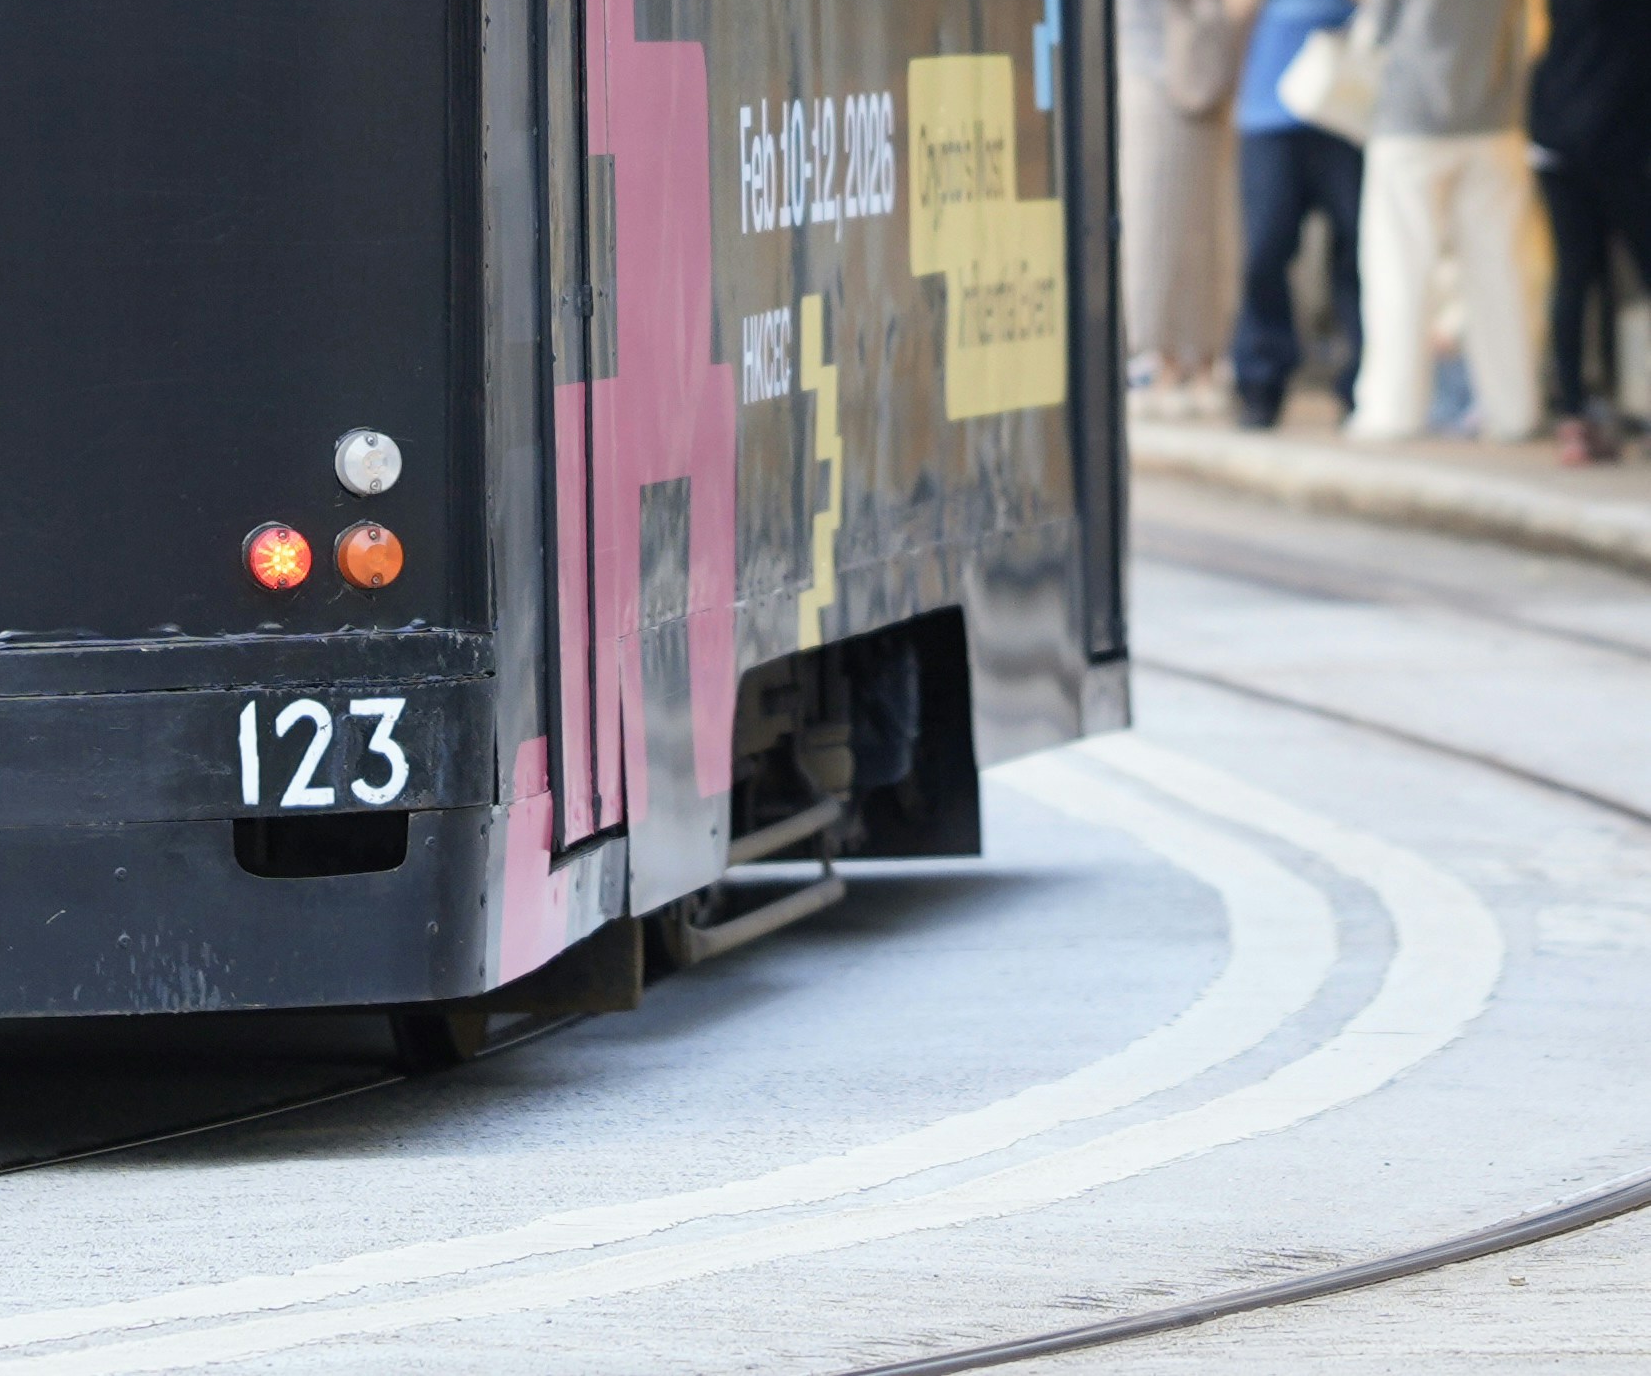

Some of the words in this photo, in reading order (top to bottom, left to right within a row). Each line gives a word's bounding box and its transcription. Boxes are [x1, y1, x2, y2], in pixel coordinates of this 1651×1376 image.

[739, 97, 776, 234] Feb
[780, 96, 844, 243] 10-12,
[845, 92, 893, 217] 2026
[743, 306, 792, 405] HKCEC
[238, 697, 409, 809] 123
